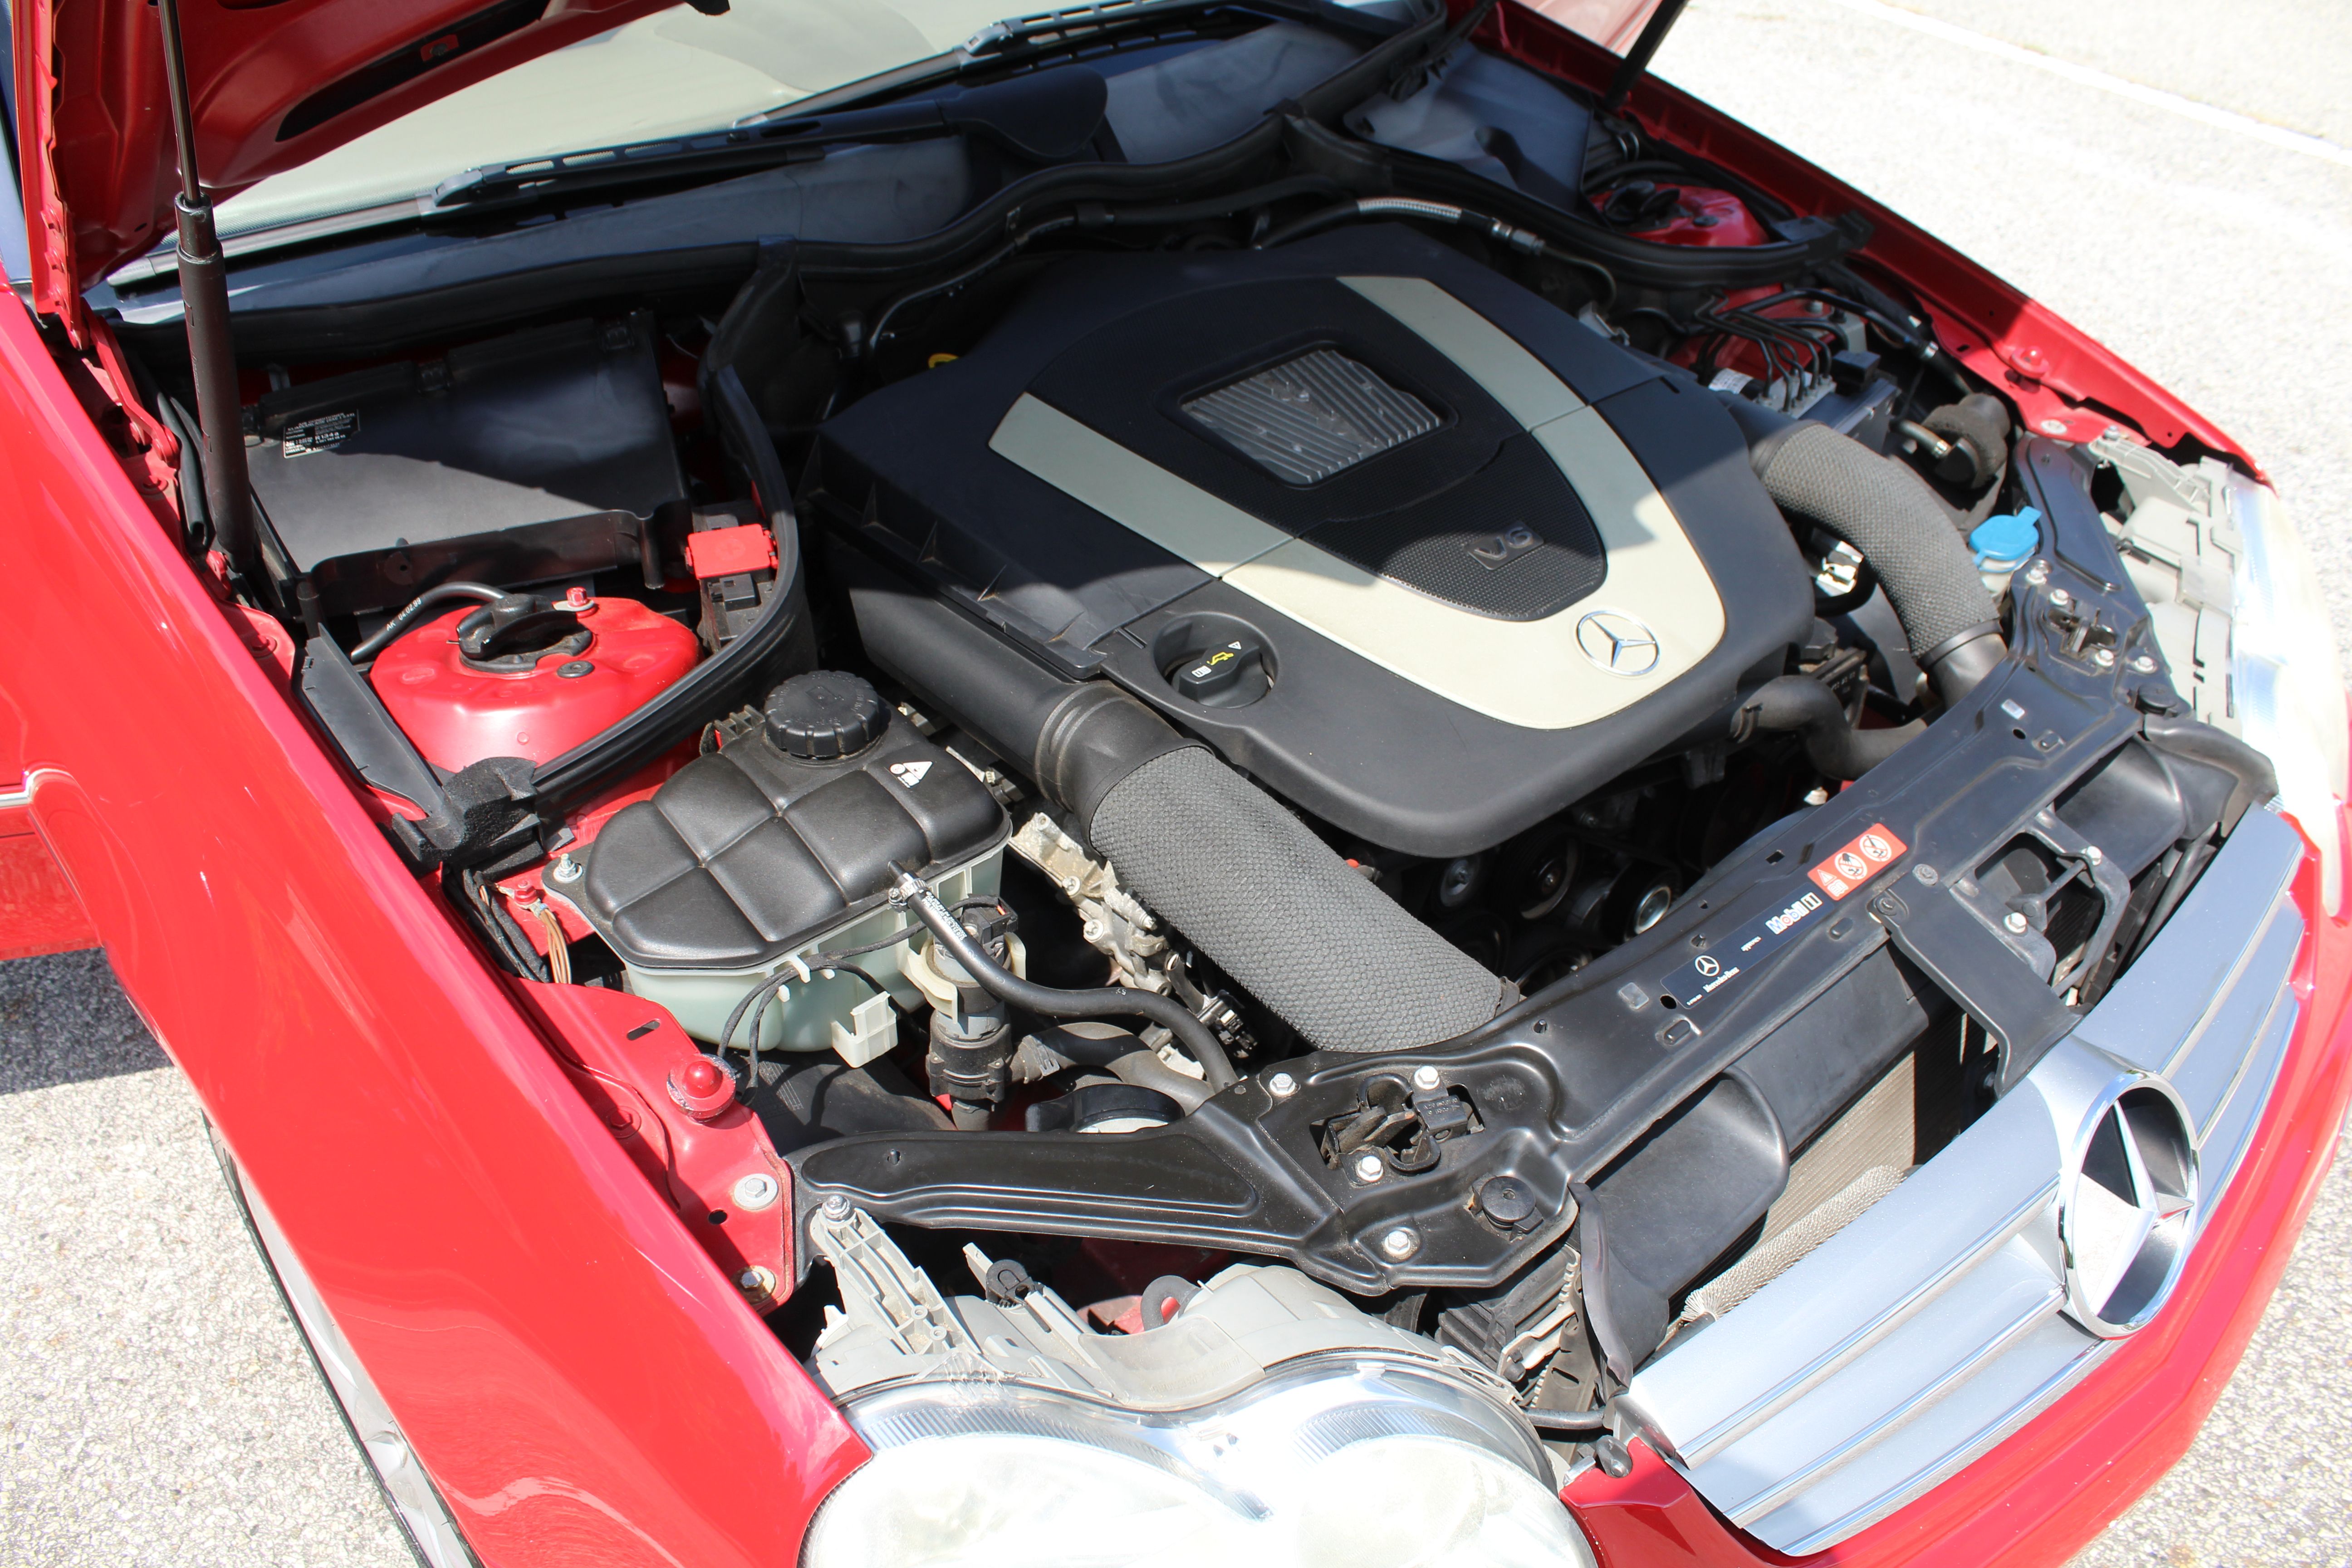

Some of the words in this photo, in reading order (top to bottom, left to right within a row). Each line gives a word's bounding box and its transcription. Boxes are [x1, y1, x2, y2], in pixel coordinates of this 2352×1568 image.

[1474, 527, 1533, 561] V6
[1765, 901, 1810, 935] Mobil
[1702, 966, 1740, 993] Mercedes-Benz
